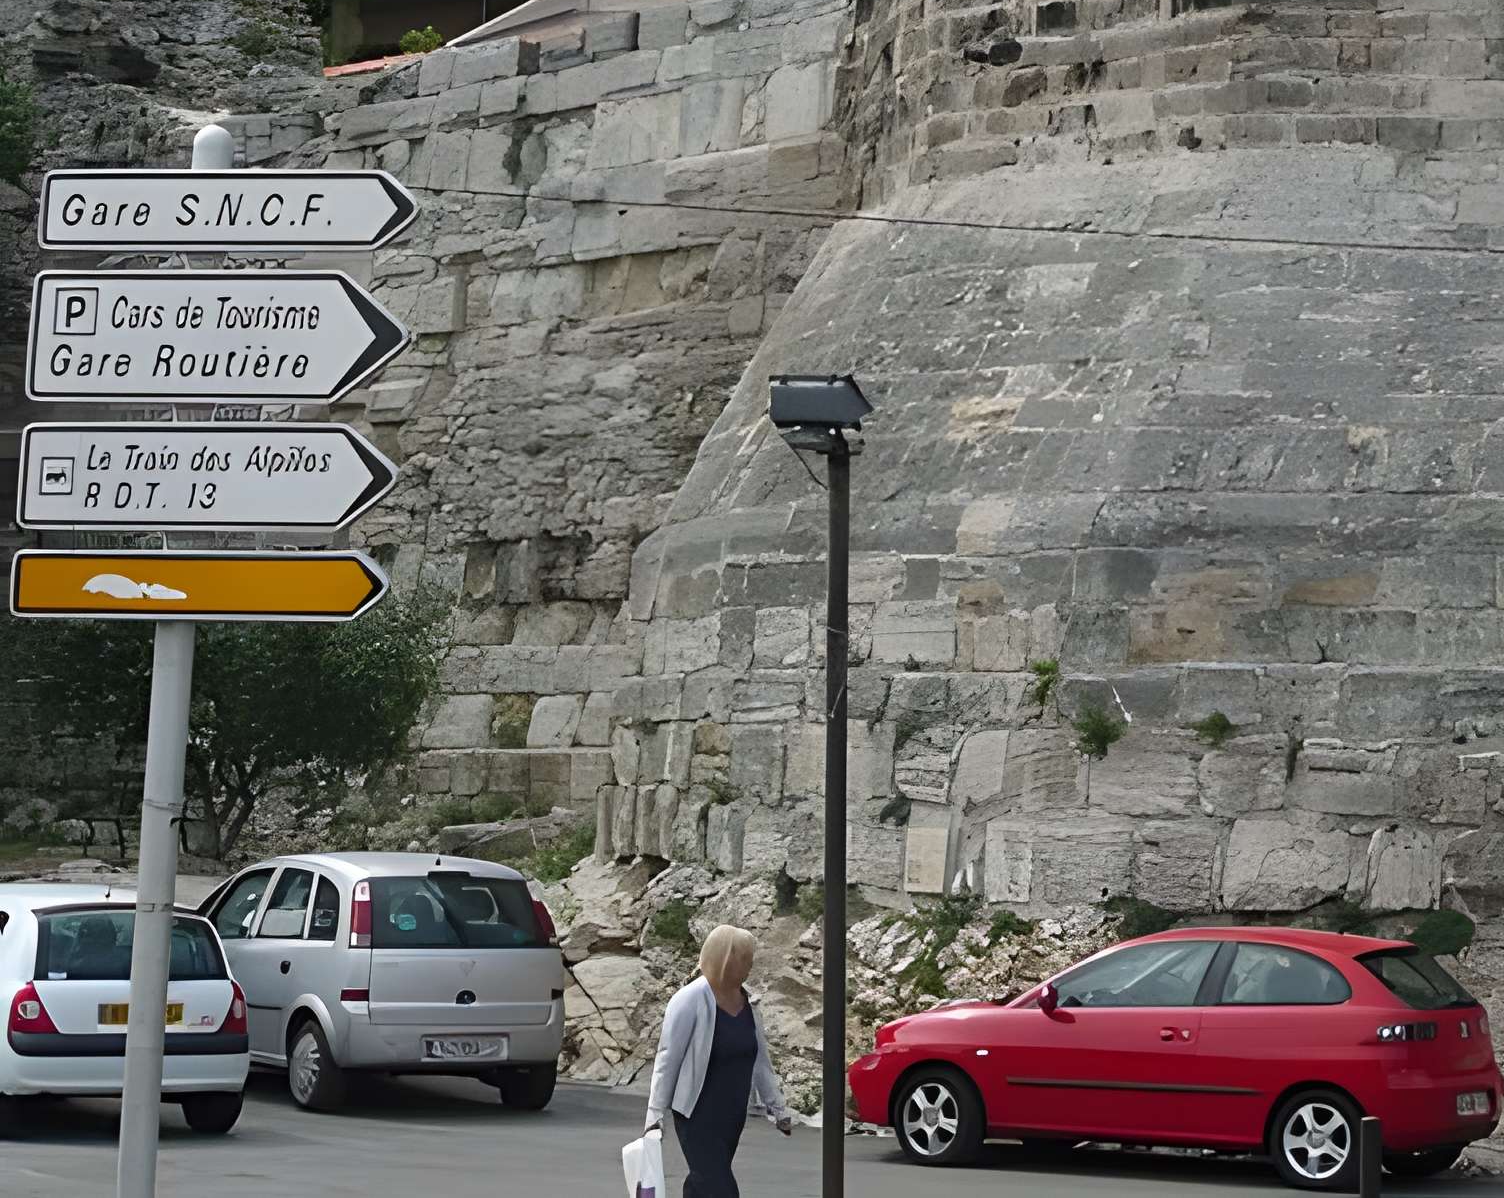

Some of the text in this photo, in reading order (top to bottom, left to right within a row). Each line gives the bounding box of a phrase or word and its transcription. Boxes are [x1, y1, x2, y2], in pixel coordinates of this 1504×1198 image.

[61, 192, 334, 227] Gare S.N.C.F.
[65, 296, 86, 328] P
[111, 295, 320, 330] Cars de Tourisme
[50, 343, 309, 378] Gare Routière
[124, 444, 180, 471] Train
